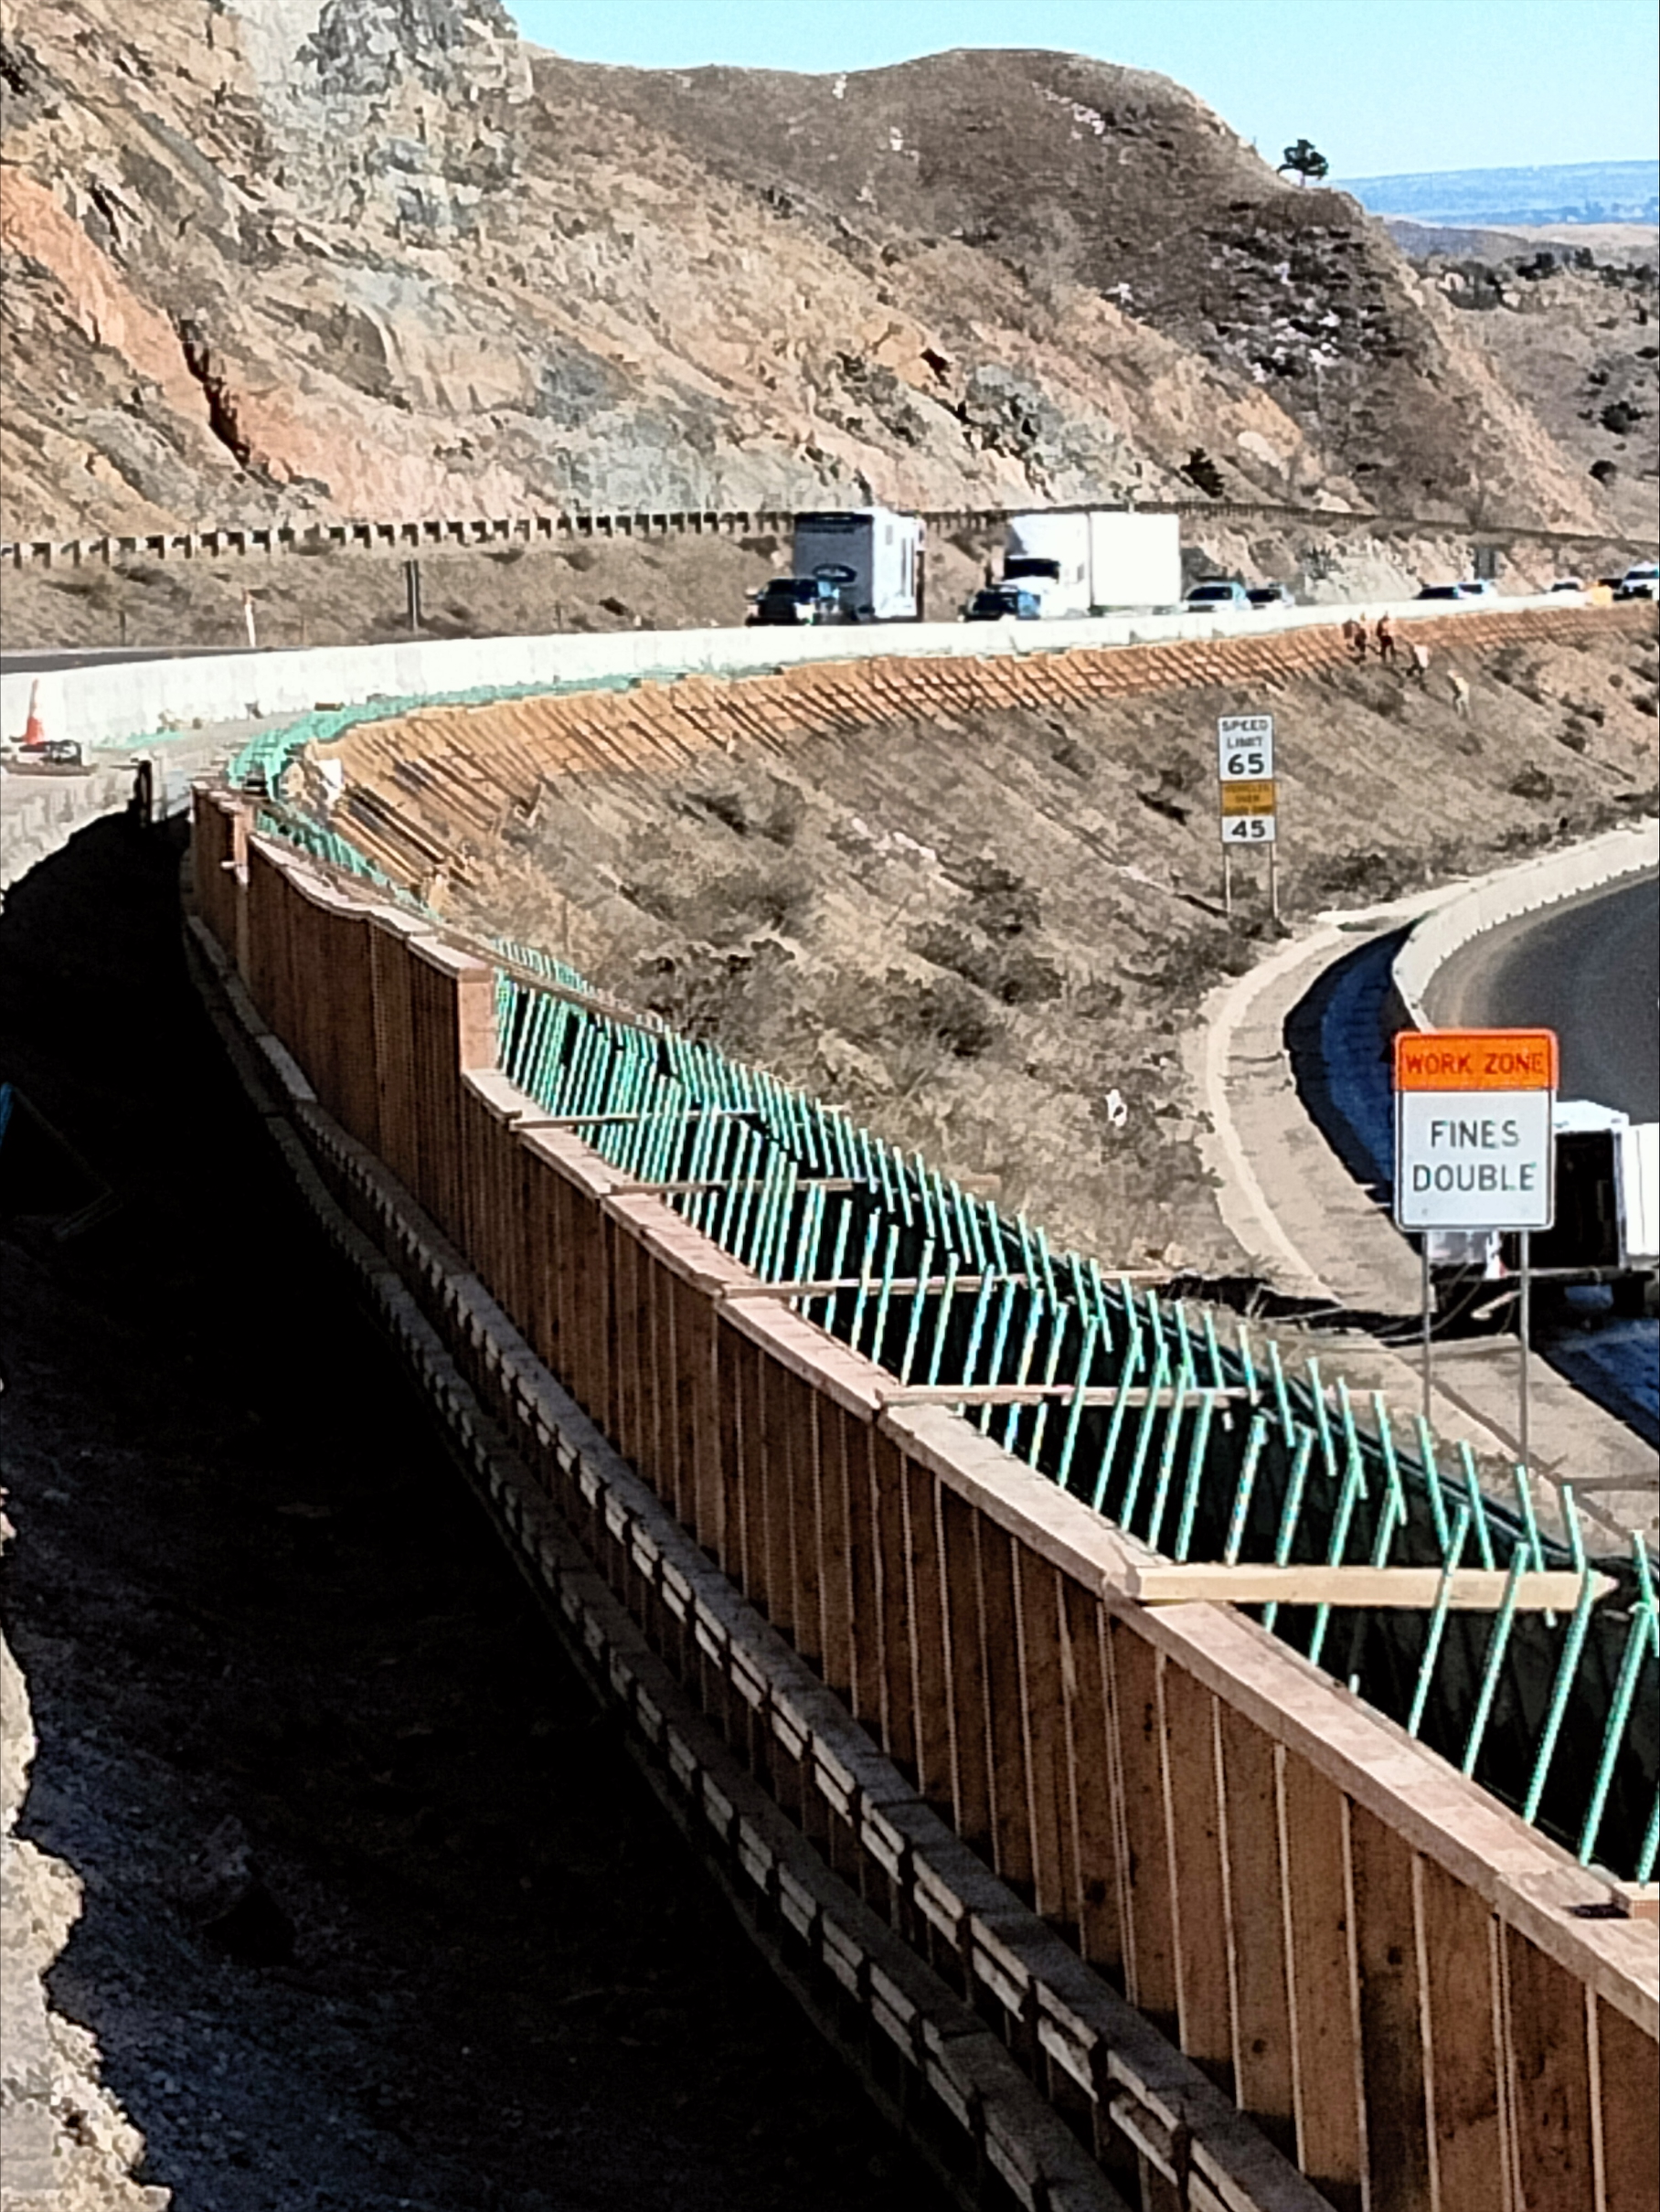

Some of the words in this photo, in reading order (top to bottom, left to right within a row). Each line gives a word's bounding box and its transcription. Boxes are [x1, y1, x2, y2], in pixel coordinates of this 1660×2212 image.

[1222, 719, 1269, 731] SPEED
[1227, 736, 1263, 750] LIMIT
[1228, 752, 1265, 775] 65
[1231, 819, 1266, 838] 45
[1405, 1052, 1472, 1075] WORK
[1484, 1052, 1544, 1075] ZONE
[1431, 1120, 1520, 1149] FINES
[1412, 1162, 1538, 1192] DOUBLE
